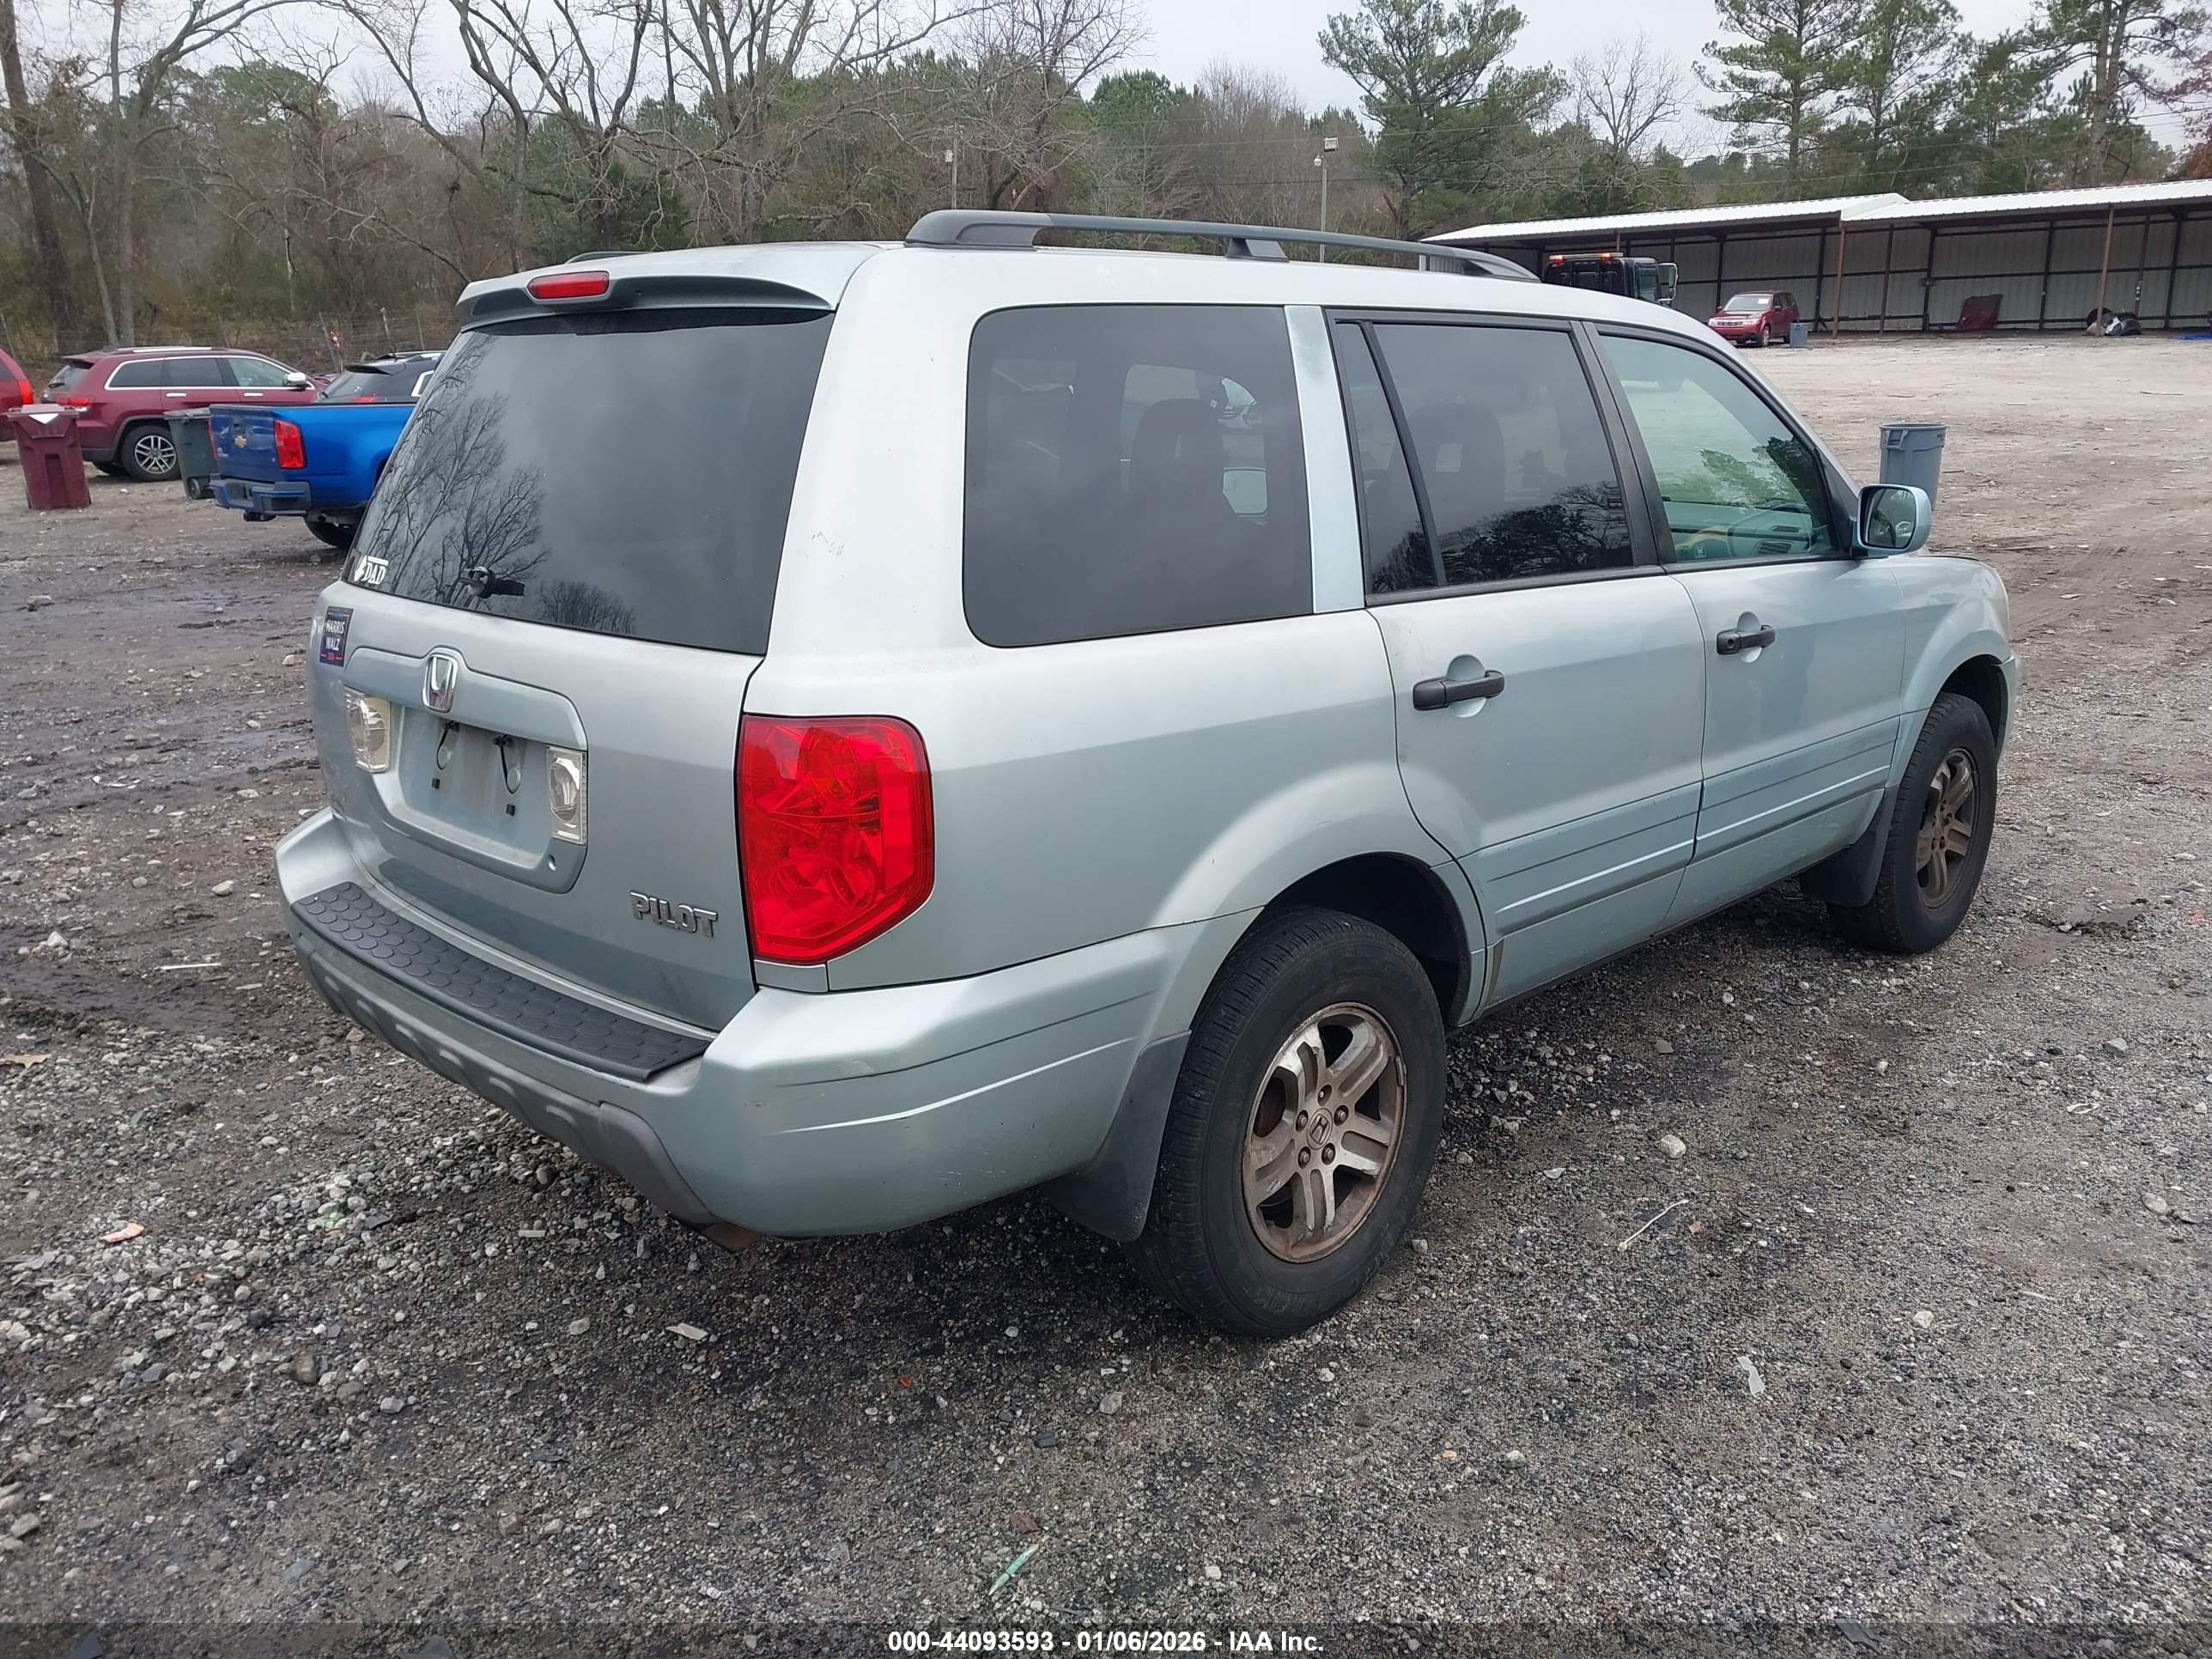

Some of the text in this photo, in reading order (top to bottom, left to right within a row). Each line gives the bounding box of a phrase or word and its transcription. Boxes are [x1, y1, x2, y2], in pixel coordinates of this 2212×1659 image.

[361, 562, 386, 584] DAD
[325, 636, 340, 651] WALZ
[629, 890, 718, 939] PILOT
